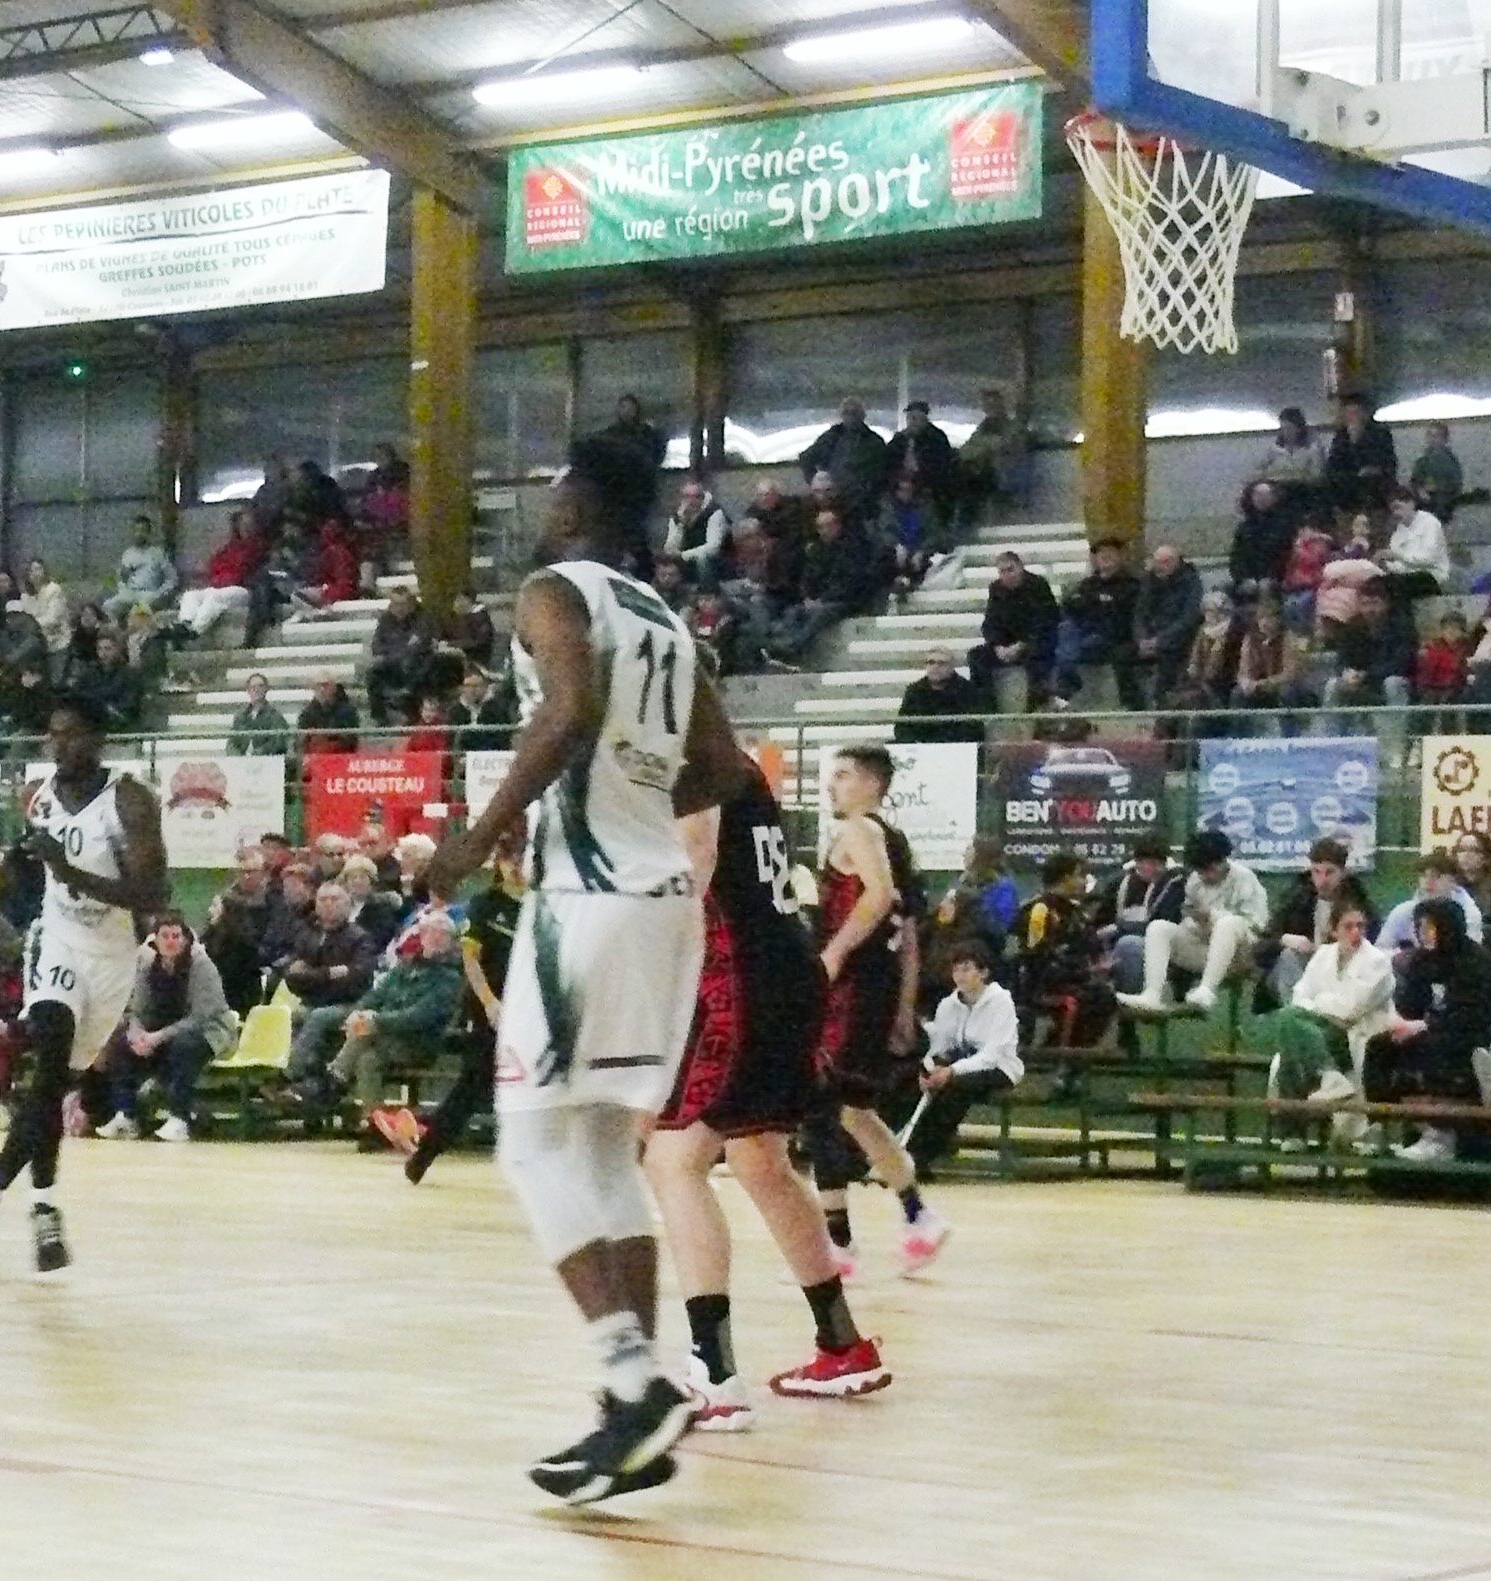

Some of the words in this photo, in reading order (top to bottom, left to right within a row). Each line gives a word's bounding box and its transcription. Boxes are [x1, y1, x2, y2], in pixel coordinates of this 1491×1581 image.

[596, 131, 850, 196] Midi-Pyrénées
[767, 152, 932, 240] sport
[162, 200, 255, 230] VITICOLES
[622, 216, 667, 241] une
[674, 204, 749, 241] région
[234, 236, 271, 252] TOUS
[98, 265, 156, 284] GREFFES
[158, 256, 220, 277] SOUDÉES
[232, 253, 268, 269] POTS
[636, 628, 678, 735] 11
[326, 777, 344, 794] LE
[346, 775, 426, 794] COUSTEAU
[57, 824, 84, 857] 10
[49, 965, 76, 992] 10
